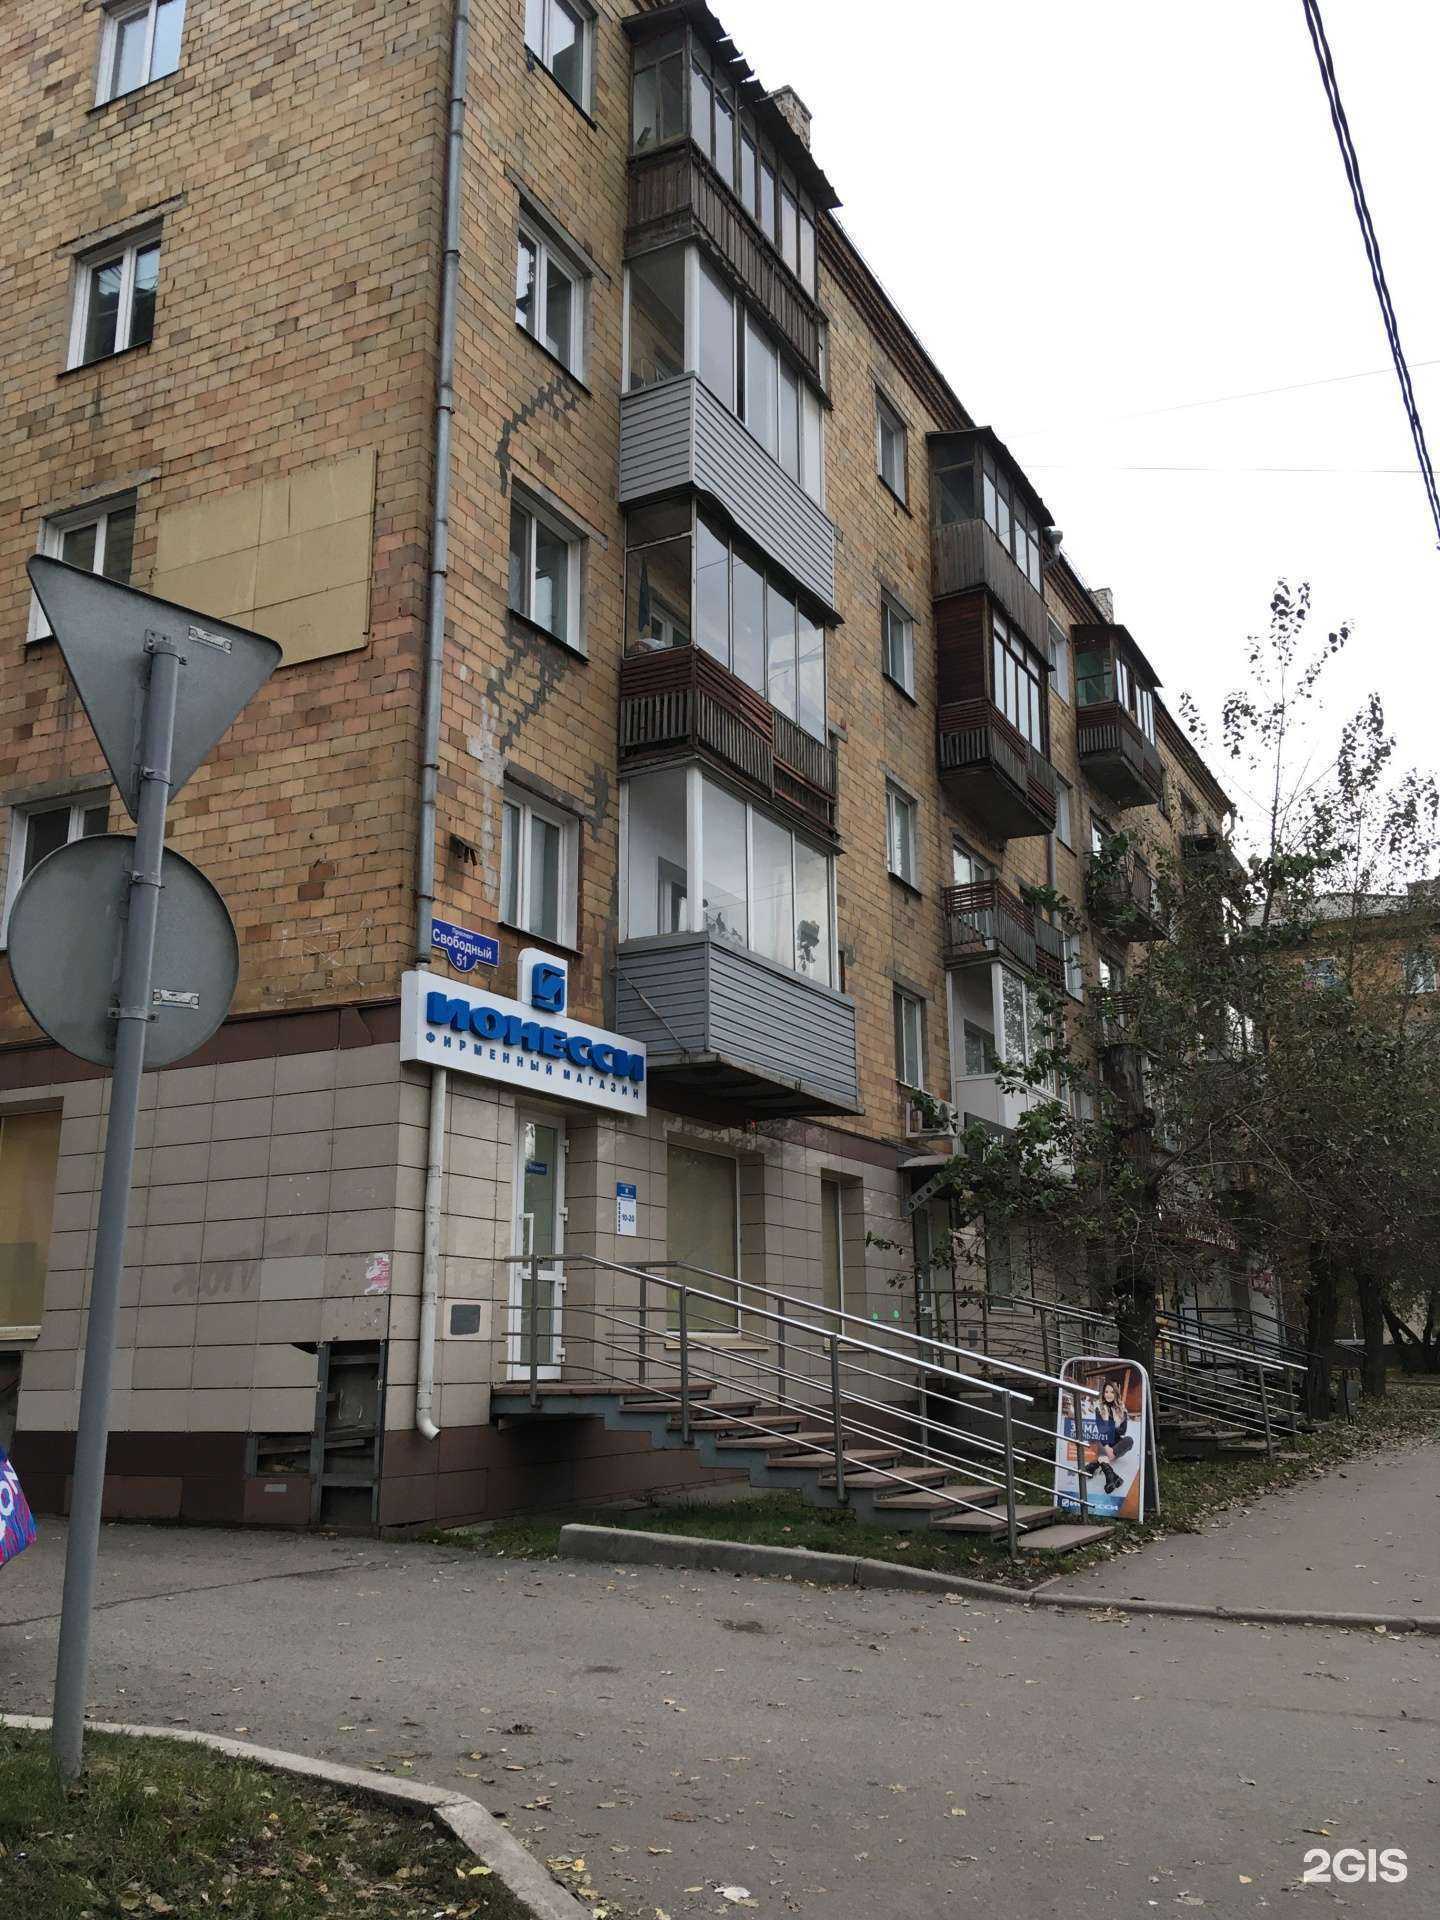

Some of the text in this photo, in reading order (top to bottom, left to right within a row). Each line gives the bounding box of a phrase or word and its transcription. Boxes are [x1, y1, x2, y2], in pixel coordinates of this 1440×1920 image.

[432, 928, 492, 960] Свободный
[456, 953, 468, 969] 51
[426, 991, 645, 1082] ИОНЕССИ
[425, 1031, 640, 1100] ФИРМЕННЫЙ МАГАЗИН
[1070, 1422, 1099, 1434] ЗМА
